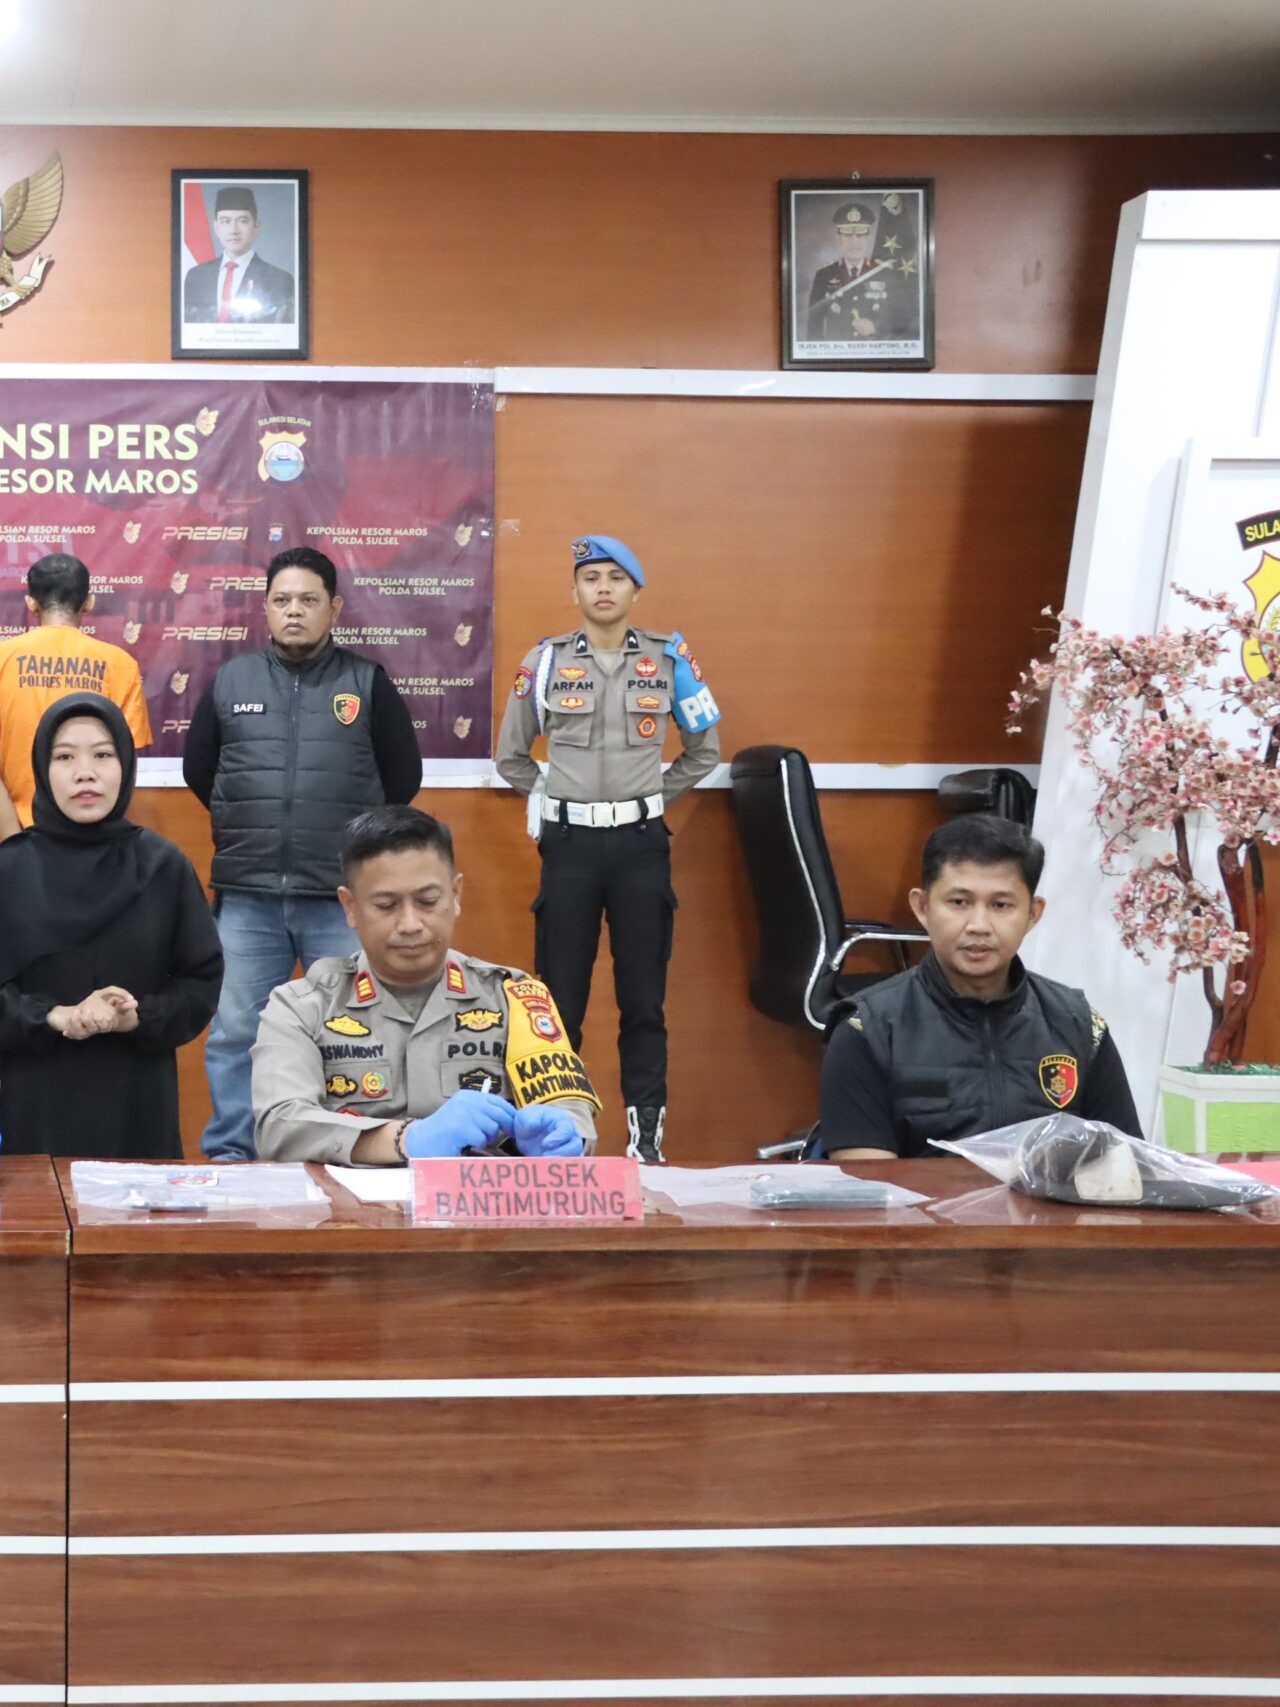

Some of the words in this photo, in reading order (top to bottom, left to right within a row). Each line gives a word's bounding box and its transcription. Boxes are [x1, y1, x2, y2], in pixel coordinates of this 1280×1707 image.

[89, 423, 199, 461] PERS
[85, 468, 199, 495] MAROS
[29, 525, 59, 534] RESOR
[61, 525, 96, 534] MAROS
[161, 527, 248, 541] PRESISI
[361, 527, 391, 536] RESOR
[394, 528, 428, 537] MAROS
[0, 535, 31, 543] POLDA
[33, 535, 67, 543] SULSEL
[332, 536, 363, 544] POLDA
[366, 537, 399, 545] SULSEL
[89, 576, 107, 584] SOR
[109, 576, 144, 584] MAROS
[209, 576, 267, 590] PRES
[408, 578, 439, 586] RESOR
[440, 578, 475, 587] MAROS
[379, 586, 411, 595] POLDA
[412, 587, 446, 595] SULSEL
[161, 627, 248, 641] PRESISI
[331, 627, 359, 636] LSIAN
[361, 627, 391, 636] RESOR
[393, 628, 427, 637] MAROS
[333, 636, 363, 644] POLDA
[365, 637, 399, 645] SULSEL
[16, 654, 107, 680] TAHANAN
[19, 676, 61, 689] POLRES
[64, 677, 103, 693] MAROS
[409, 678, 438, 686] RESOR
[440, 678, 474, 686] MAROS
[552, 681, 593, 691] ARFAH
[627, 679, 668, 690] POLRI
[412, 687, 446, 695] SULSEL
[233, 704, 263, 713] SAFEI
[447, 1040, 503, 1059] POLR
[459, 1163, 599, 1189] KAPOLSEK
[435, 1191, 625, 1217] BANTIMURUNG
